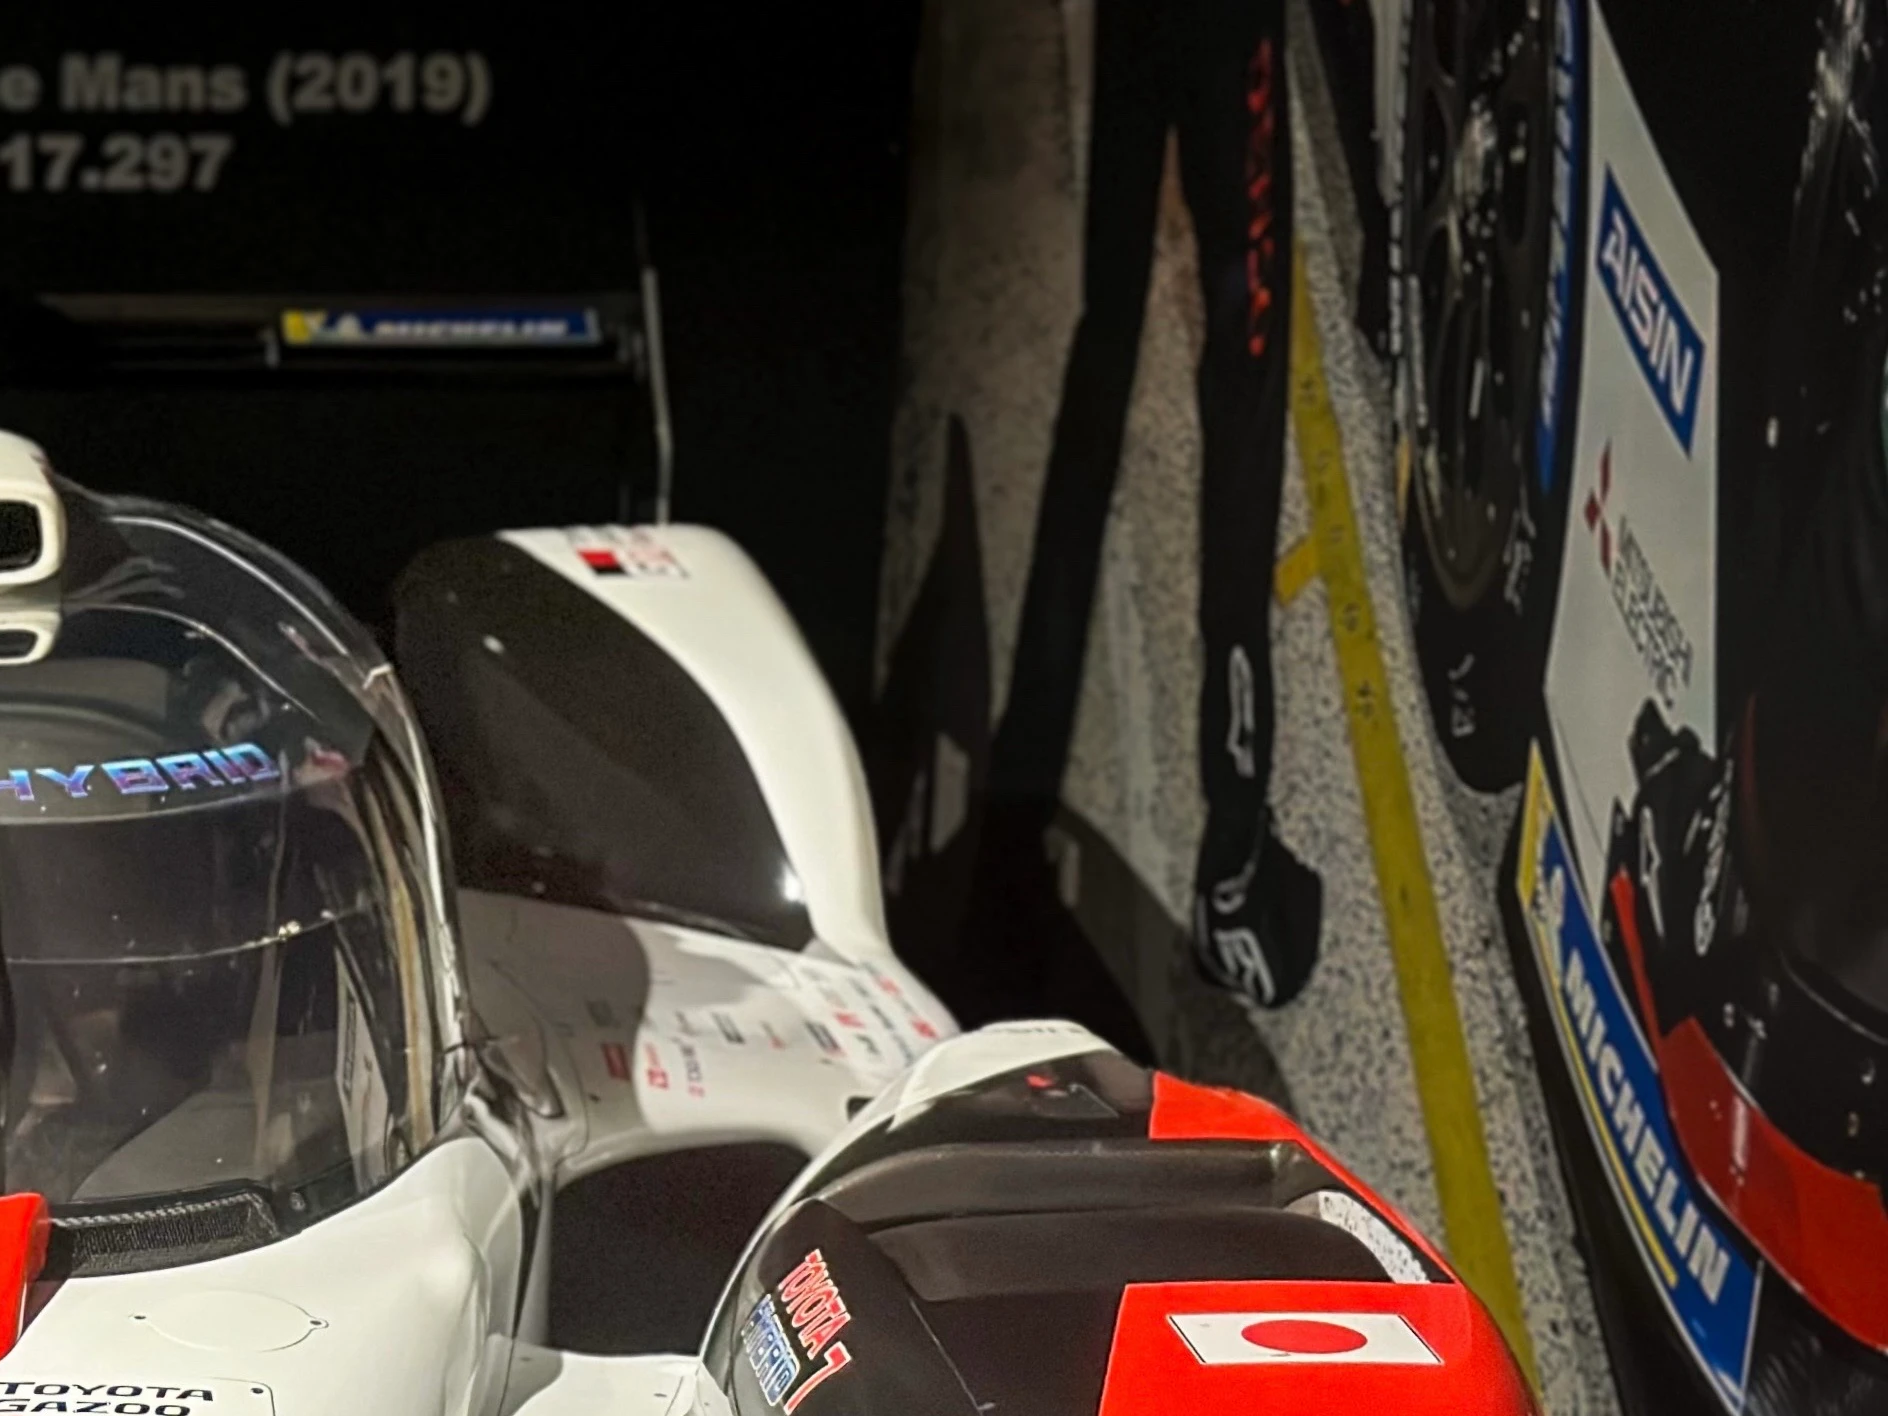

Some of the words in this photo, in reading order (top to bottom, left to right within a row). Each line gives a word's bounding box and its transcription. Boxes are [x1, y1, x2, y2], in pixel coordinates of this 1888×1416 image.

[59, 52, 246, 112] Mans
[268, 52, 490, 124] (2019)
[1602, 208, 1694, 417] AISIN
[1562, 947, 1731, 1304] MICHELIN
[777, 1248, 852, 1361] TOYOTA
